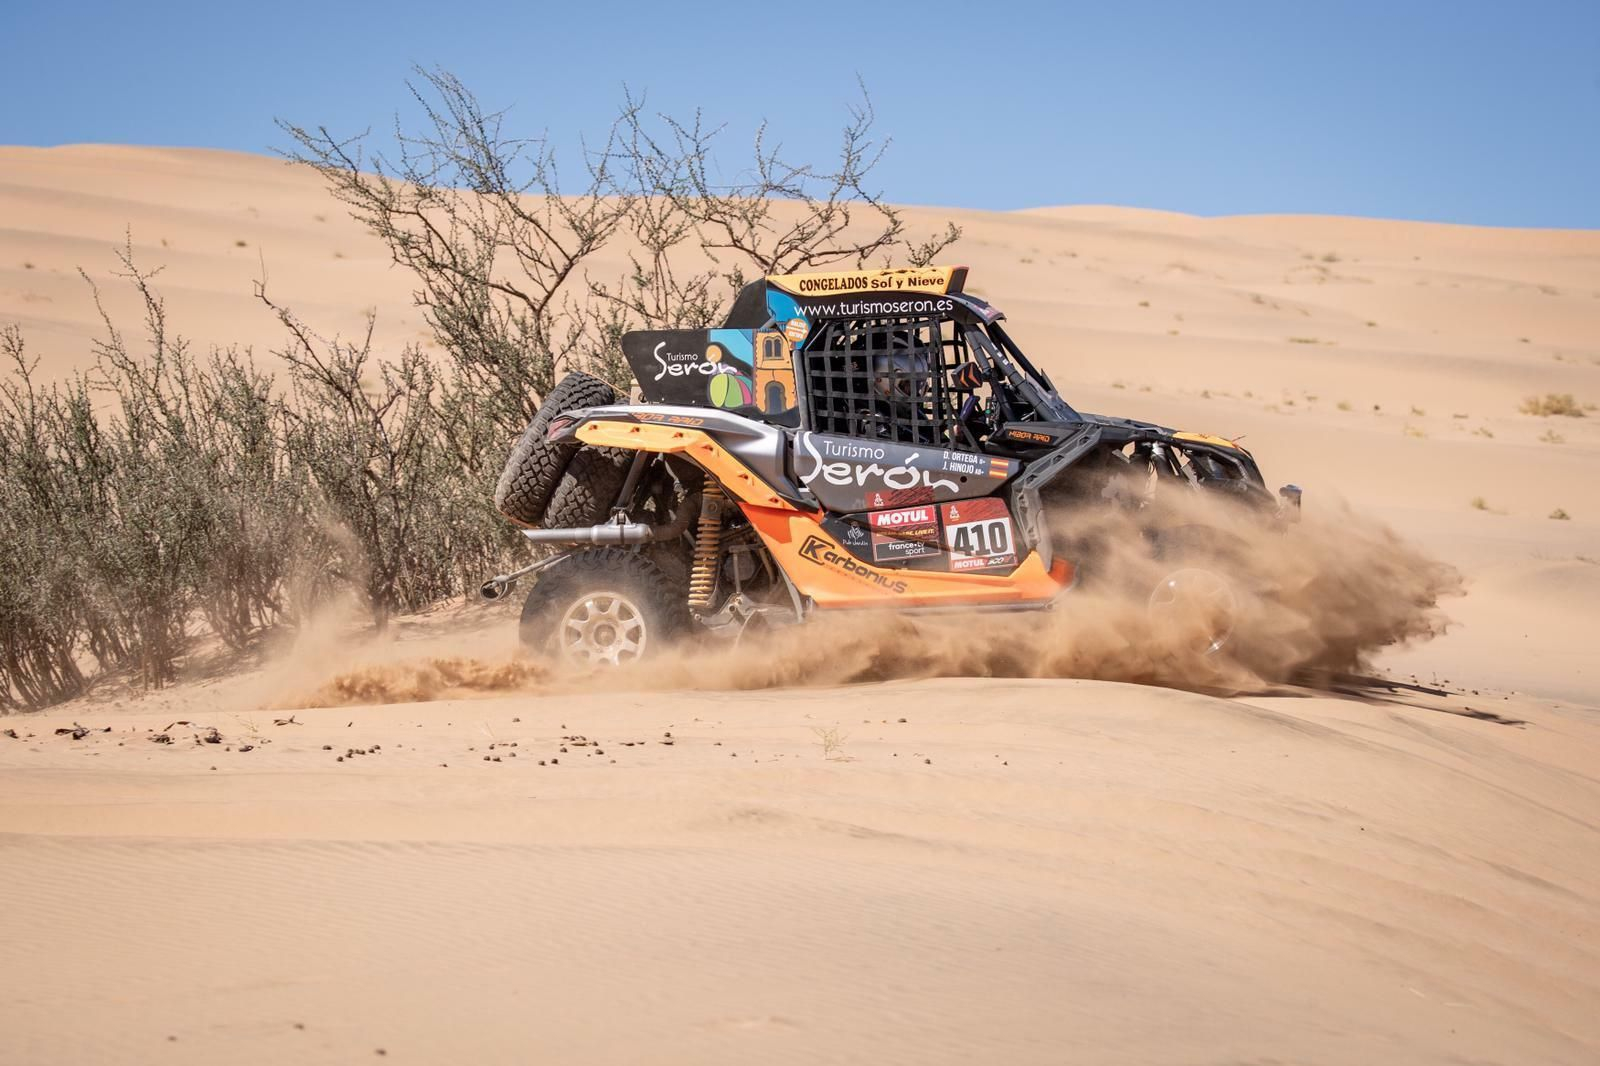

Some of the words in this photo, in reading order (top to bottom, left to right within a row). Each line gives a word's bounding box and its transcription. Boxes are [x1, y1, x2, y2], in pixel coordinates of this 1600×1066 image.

[800, 277, 868, 291] CONGELADOS
[871, 277, 893, 288] Sol
[896, 279, 904, 288] y
[907, 277, 944, 287] Nieve
[794, 300, 954, 316] www.turismoseron.es
[666, 352, 698, 361] Turismo
[824, 440, 885, 460] Turismo
[943, 451, 950, 460] D.
[952, 452, 978, 464] ORTEGA
[800, 431, 960, 493] Serón
[942, 461, 949, 471] J.
[949, 461, 975, 474] HINOJO
[877, 509, 929, 526] MOTUL
[954, 521, 1008, 556] 410
[905, 548, 925, 557] sport
[803, 539, 908, 594] Karbonius
[954, 559, 985, 569] MOTUL
